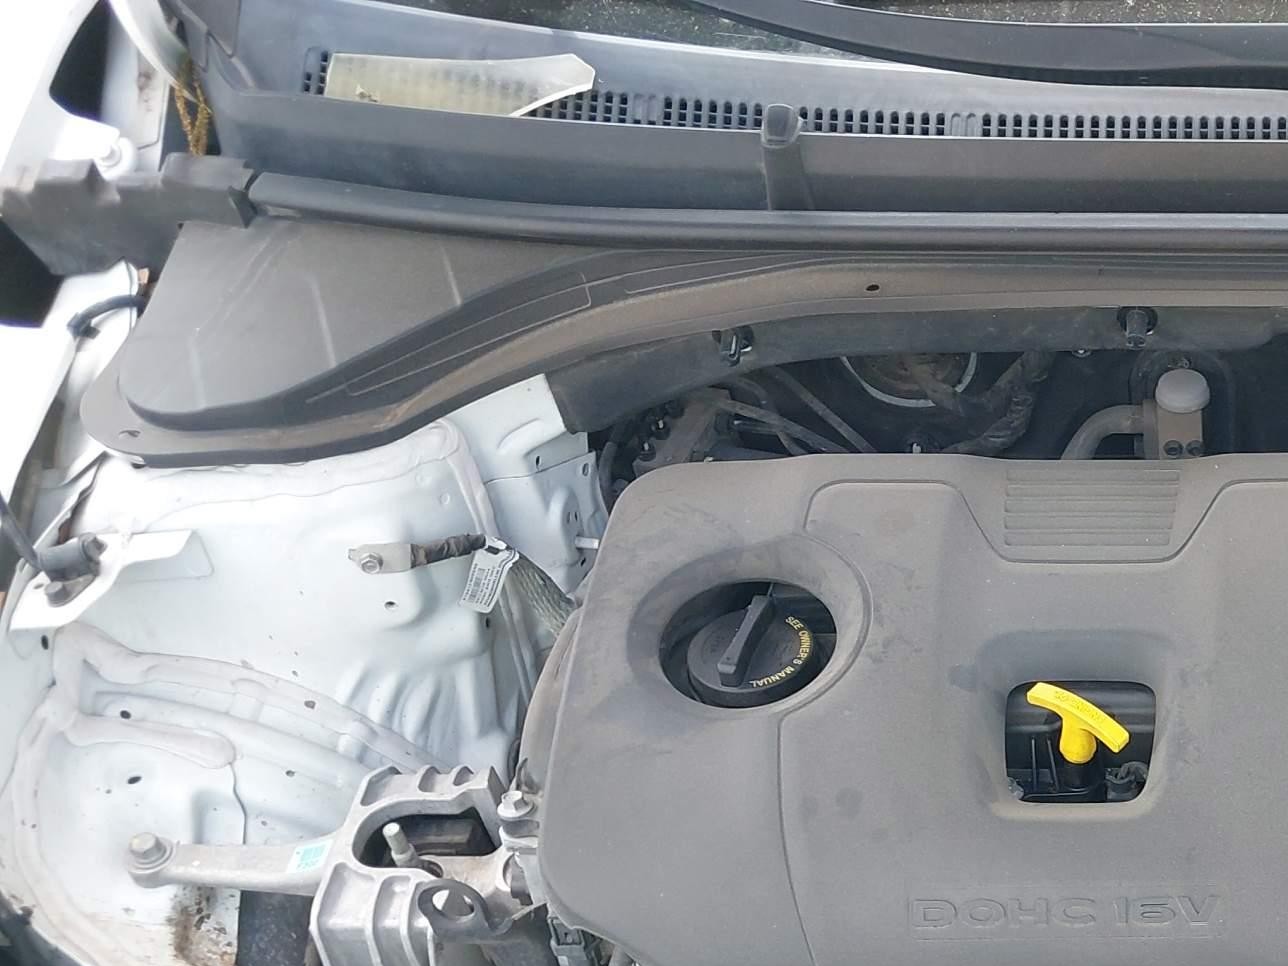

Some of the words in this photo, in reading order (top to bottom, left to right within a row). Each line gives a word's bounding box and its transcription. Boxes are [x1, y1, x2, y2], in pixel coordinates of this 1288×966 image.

[785, 615, 804, 631] SEE
[749, 665, 796, 688] MANUAL
[906, 898, 1097, 929] DOHC
[1112, 896, 1221, 927] 16V
